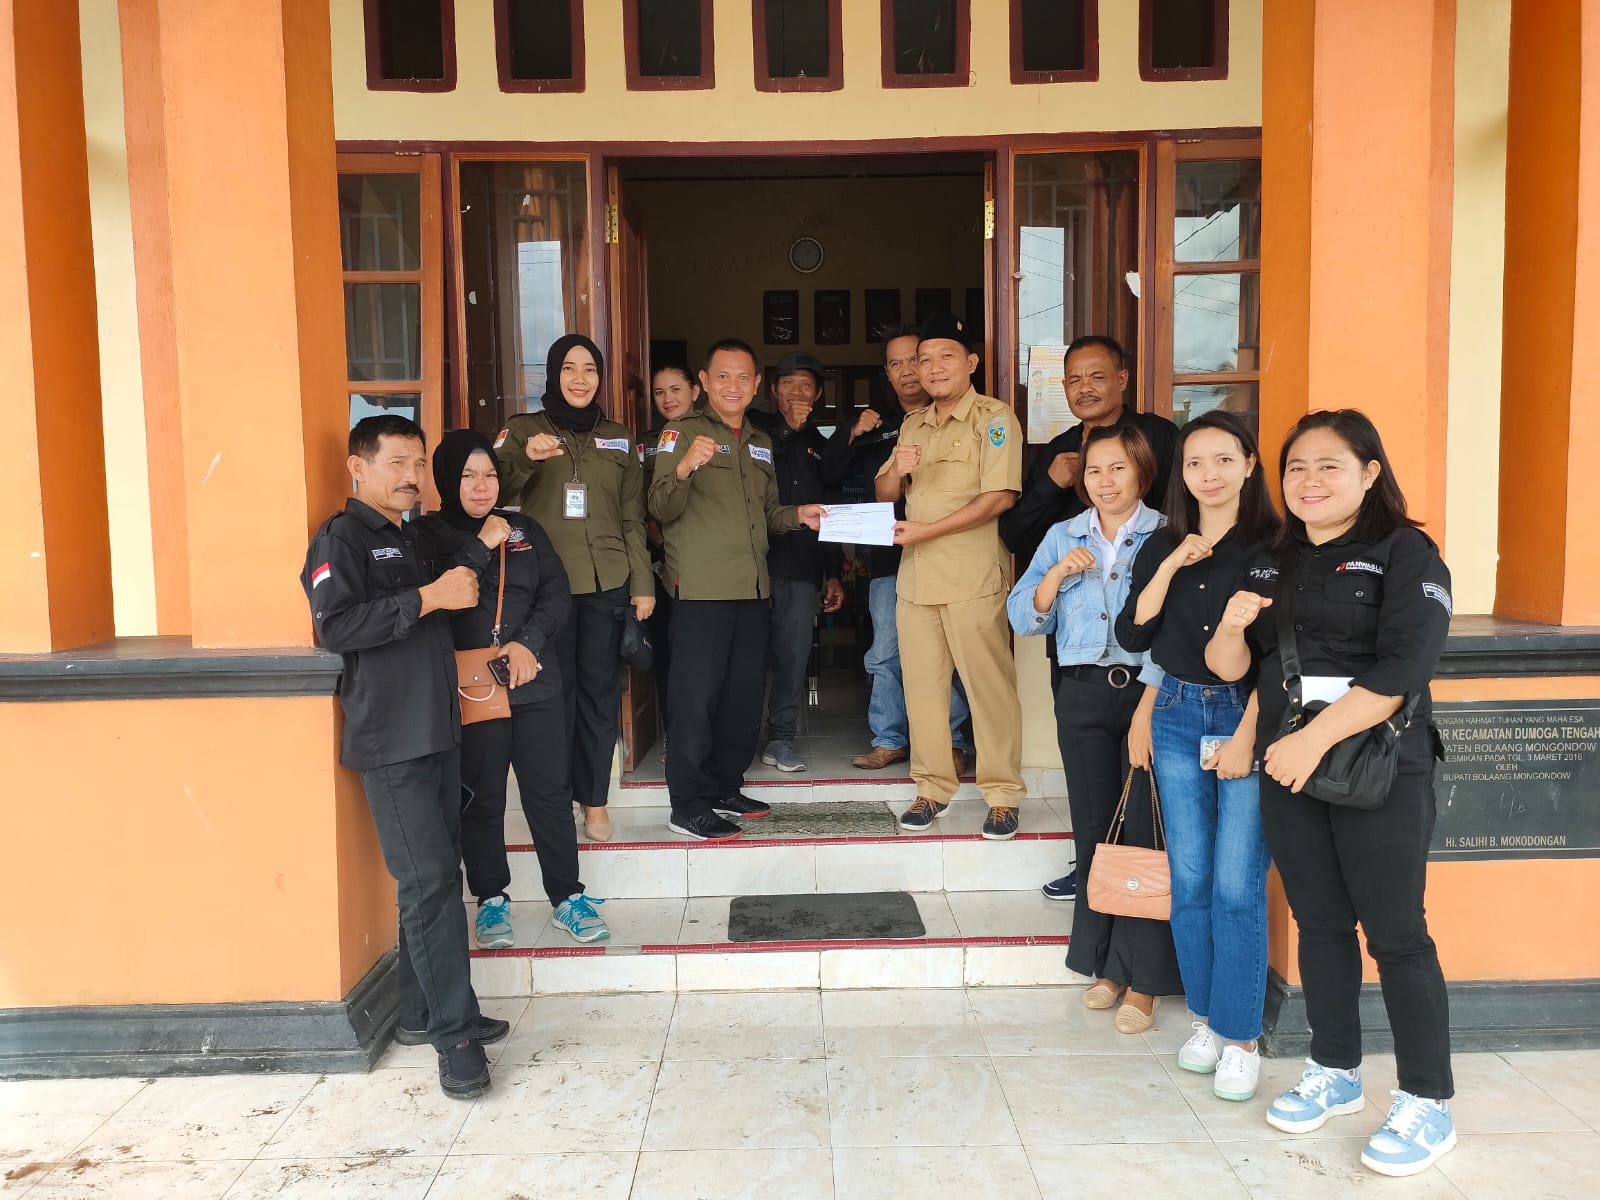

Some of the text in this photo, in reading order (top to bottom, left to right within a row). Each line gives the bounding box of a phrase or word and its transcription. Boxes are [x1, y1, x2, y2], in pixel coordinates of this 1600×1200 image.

[1465, 716, 1496, 724] RAHMAT
[1498, 716, 1523, 724] TUHAN
[1546, 715, 1568, 723] MAHA
[1568, 715, 1584, 723] ESA
[1452, 728, 1512, 741] KECAMATAN
[1514, 727, 1559, 739] DUMOGA
[1560, 726, 1600, 739] TENGAH
[1474, 743, 1523, 753] BOLAANG
[1525, 742, 1597, 752] MONGONDOW
[1444, 754, 1482, 763] ESMIKAN
[1484, 754, 1506, 762] PADA
[1526, 753, 1532, 761] 3
[1533, 753, 1563, 761] MARET
[1563, 753, 1583, 761] 2016
[1495, 763, 1518, 771] OLEH
[1442, 771, 1571, 781] BUPATI BOLAANG MONGONDOW
[1445, 835, 1566, 848] Hi. SALIHI B. MOKODONGAN
